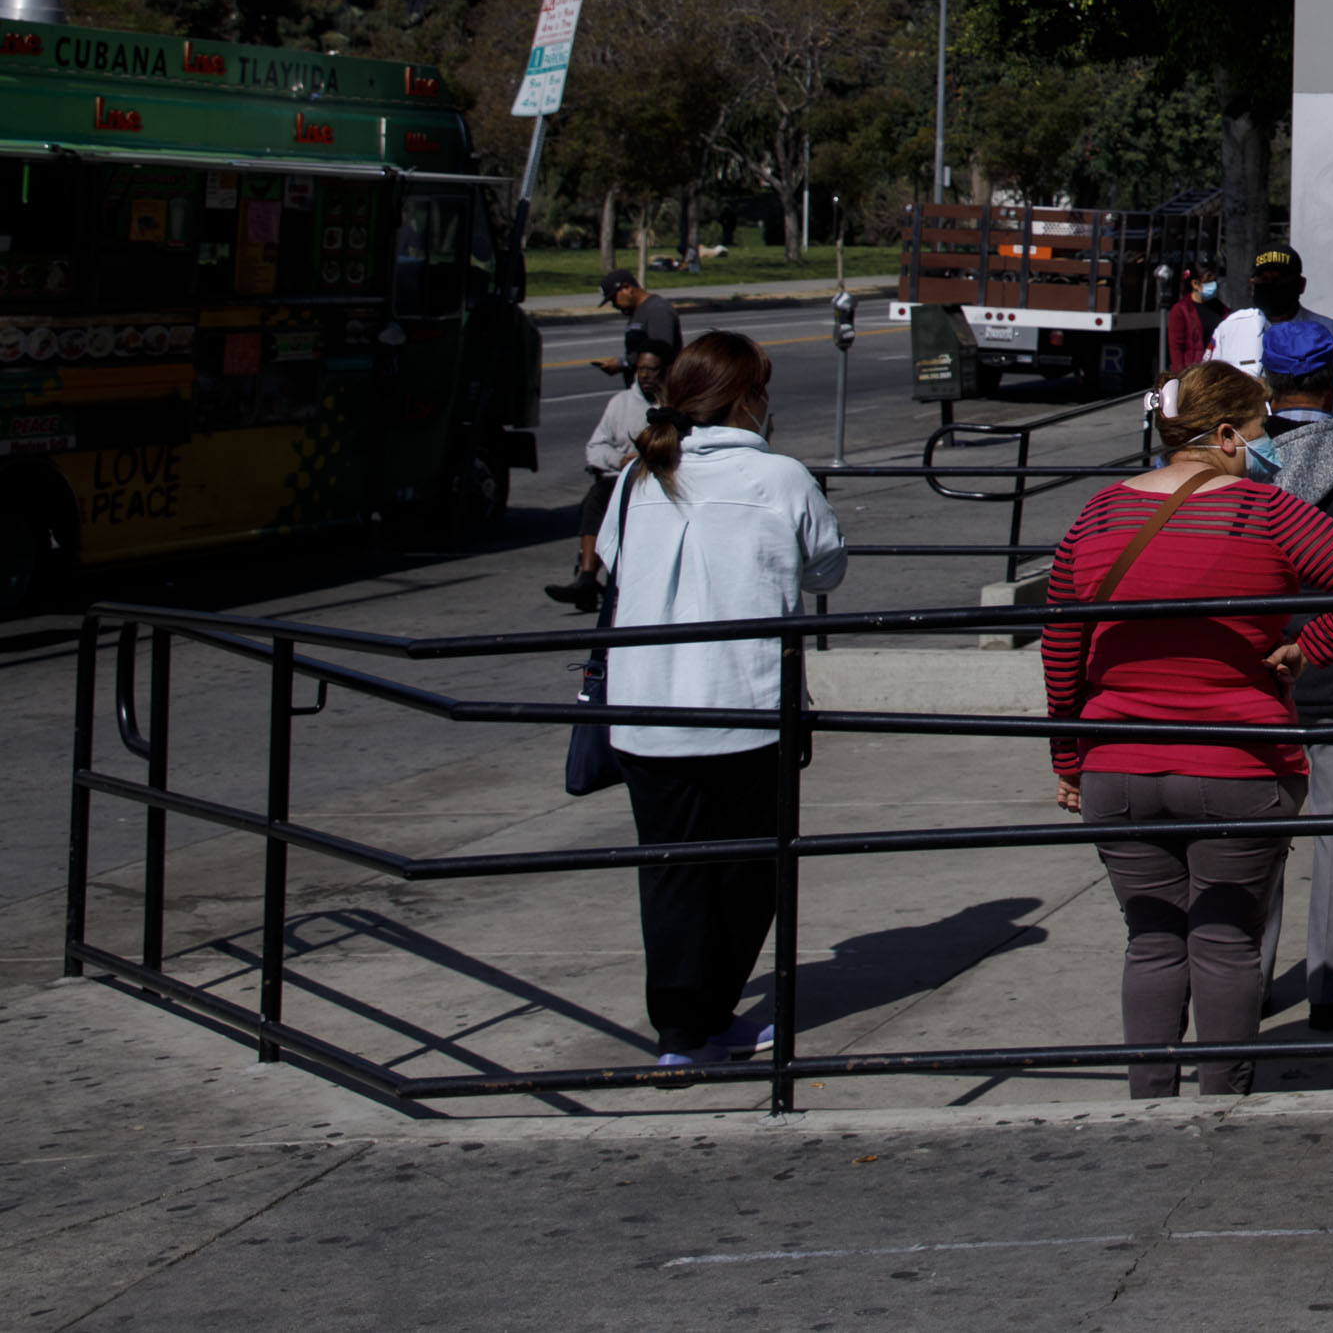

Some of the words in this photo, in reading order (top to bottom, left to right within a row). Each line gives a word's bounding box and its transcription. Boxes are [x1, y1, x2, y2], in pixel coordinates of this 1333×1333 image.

[55, 36, 167, 77] CUBANA
[239, 56, 340, 93] TLAYUDA
[1256, 250, 1291, 267] SECURITY
[94, 444, 181, 489] LOVE
[92, 484, 179, 525] PEACE
